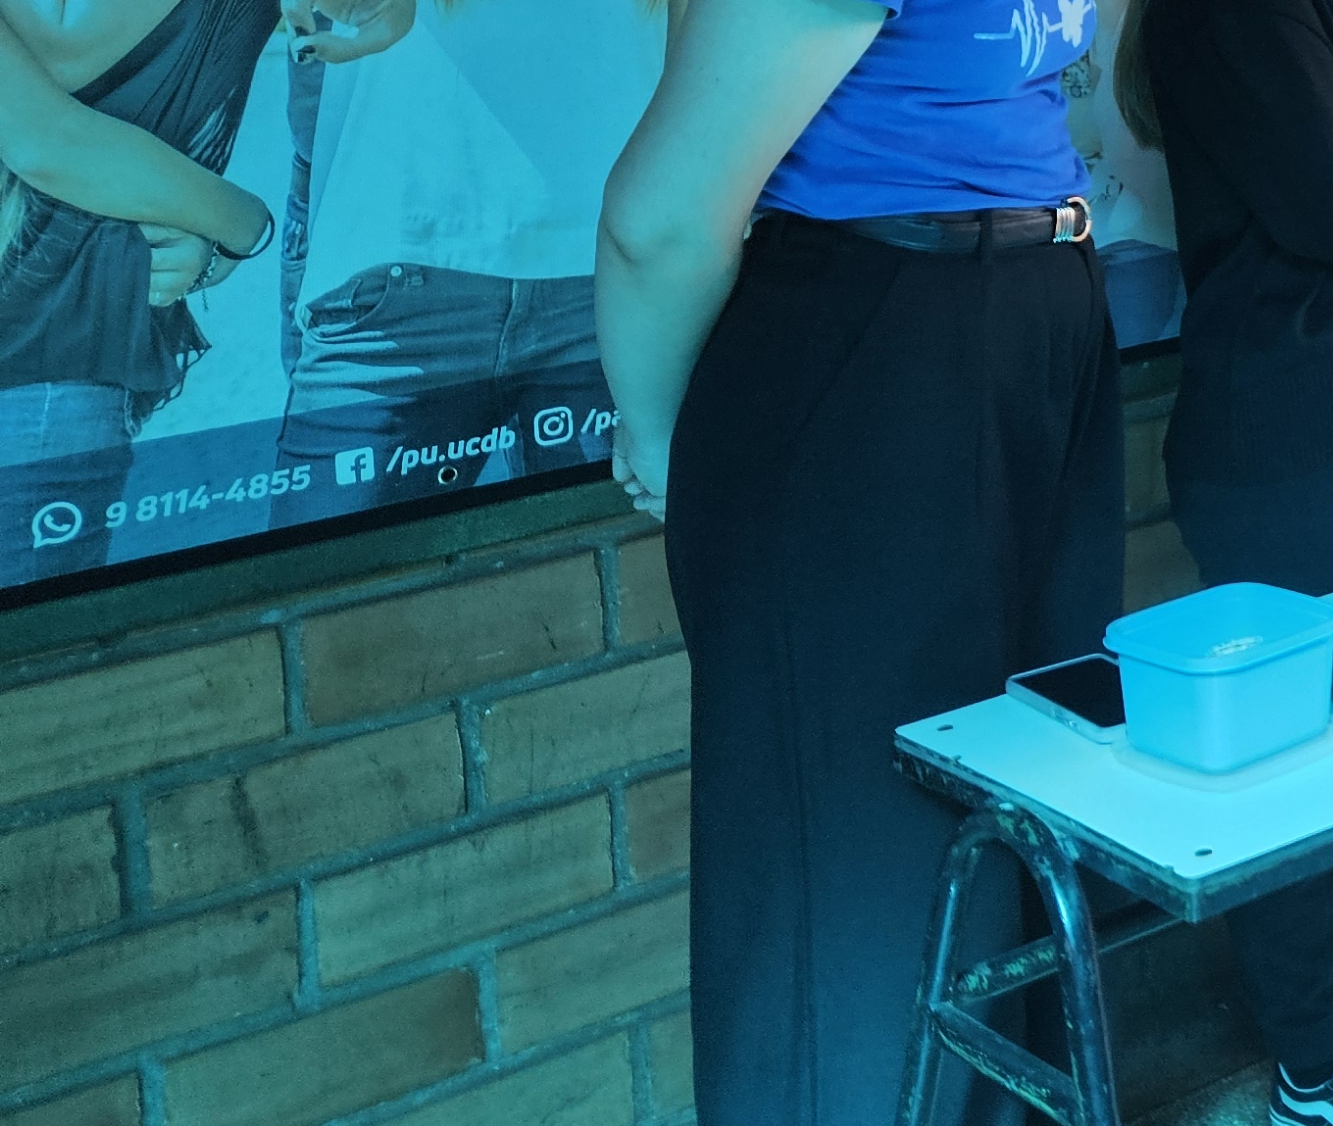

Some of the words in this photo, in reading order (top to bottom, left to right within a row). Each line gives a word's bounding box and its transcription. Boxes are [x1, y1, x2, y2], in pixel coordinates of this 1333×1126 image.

[386, 425, 516, 475] /pu.ucdb
[105, 501, 127, 528] 9
[135, 464, 311, 522] 8114-4855
